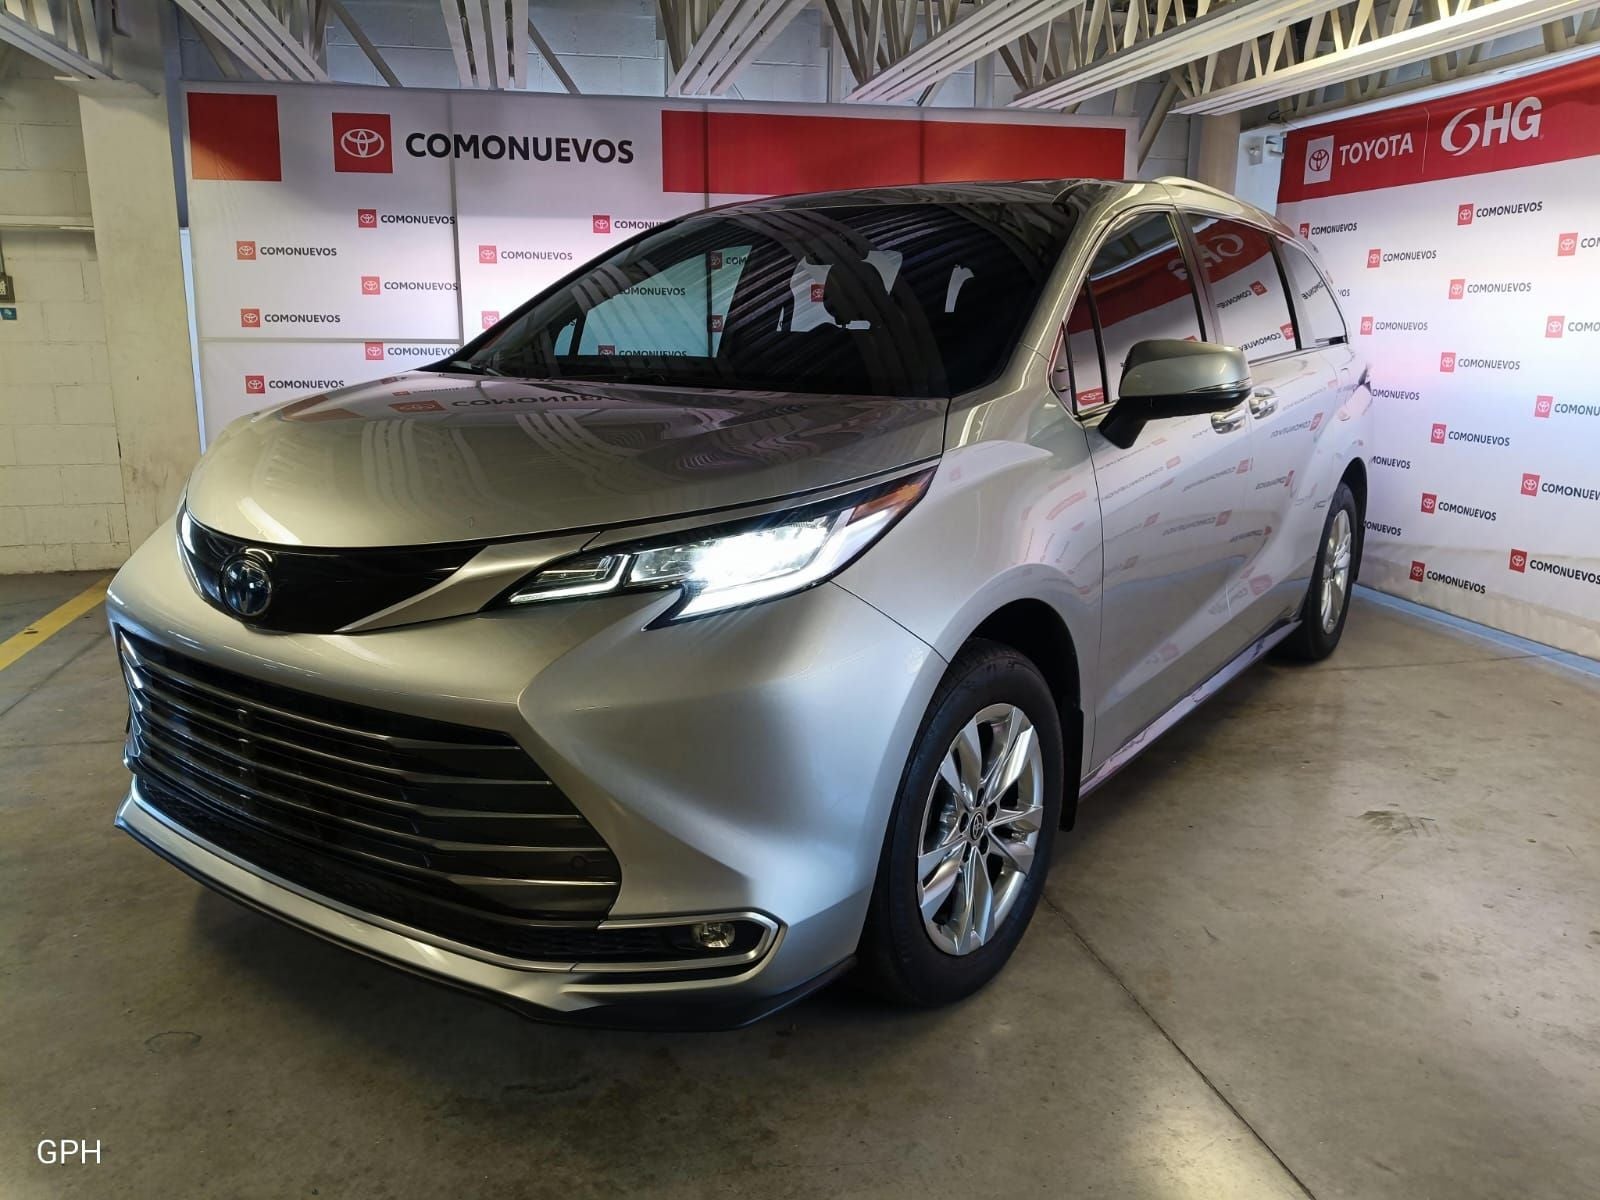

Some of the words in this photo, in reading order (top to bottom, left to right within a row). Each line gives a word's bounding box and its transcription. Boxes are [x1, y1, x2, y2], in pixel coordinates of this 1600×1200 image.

[405, 131, 634, 165] COMONUEVOS
[1339, 132, 1414, 166] TOYOTA
[1475, 201, 1543, 219] COMONUEVOS
[380, 214, 456, 225] COMONUEVOS
[1310, 222, 1358, 236] COMONUEVOS
[259, 246, 338, 257] COMONUEVOS
[500, 249, 573, 261] COMONUEVOS
[1382, 249, 1437, 263] COMONUEVOS
[384, 281, 459, 292] COMONUEVOS
[1466, 281, 1532, 295] COMONUEVOS
[264, 313, 342, 324] COMONUEVOS
[1374, 321, 1429, 332] COMONUEVOS
[1457, 357, 1521, 371] COMONUEVOS
[268, 379, 345, 390] COMONUEVOS
[1447, 430, 1511, 448] COMONUEVOS
[1437, 500, 1498, 522] COMONUEVOS
[1529, 559, 1600, 586] COMONUEVOS
[1425, 569, 1487, 595] COMONUEVOS
